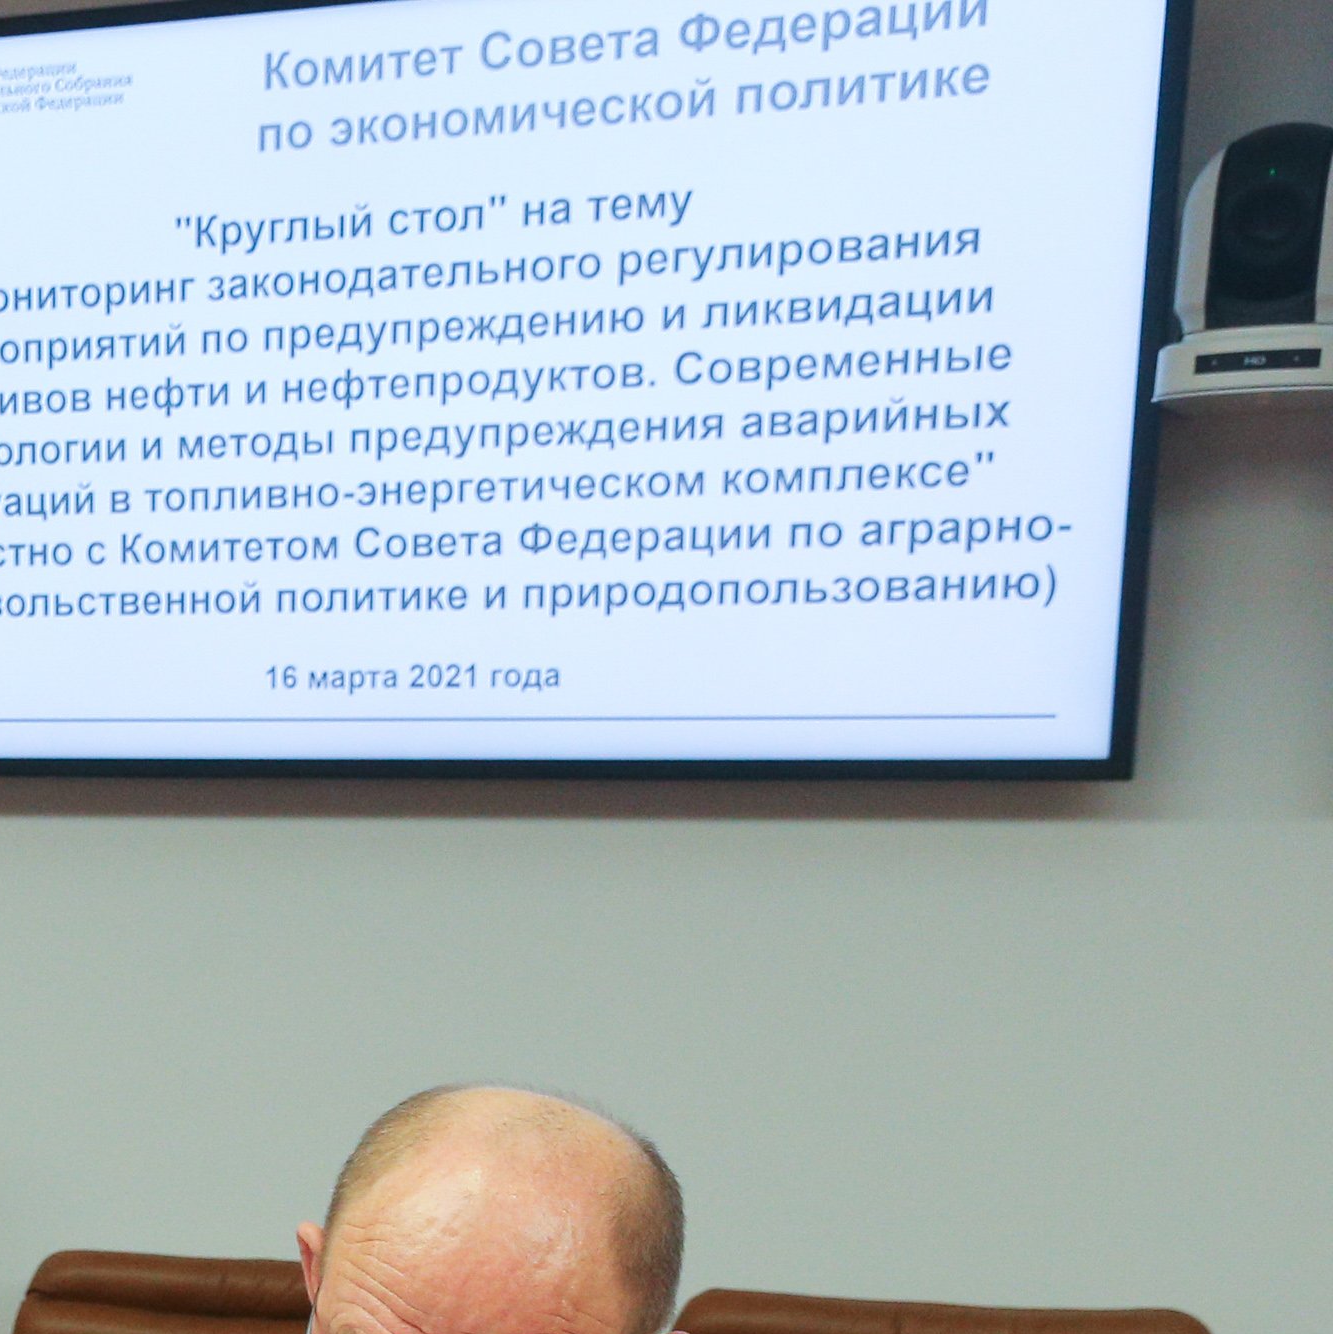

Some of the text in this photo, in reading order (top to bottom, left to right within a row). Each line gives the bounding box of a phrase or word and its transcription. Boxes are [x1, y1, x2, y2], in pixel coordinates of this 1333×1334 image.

[264, 0, 989, 91] Комитет Совета Федерации
[34, 92, 124, 112] Федерации
[258, 63, 991, 153] по экономической политике
[174, 189, 694, 257] "Круглый стол" на тему
[206, 252, 603, 302] законодательного
[617, 226, 981, 288] регулирования
[201, 326, 250, 355] по
[263, 305, 646, 360] предупреждению
[661, 303, 687, 332] и
[700, 285, 994, 330] ликвидации
[105, 375, 230, 419] нефти
[244, 379, 268, 406] и
[282, 361, 657, 411] нефтепродуктов.
[673, 342, 1014, 392] Современные
[141, 435, 163, 462] и
[177, 429, 335, 463] методы
[349, 412, 725, 463] предупреждения
[740, 396, 1011, 446] аварийных
[109, 489, 132, 515] в
[143, 469, 706, 514] топливно-энергетическом
[721, 450, 995, 496] комплексе"
[85, 540, 107, 566] с
[120, 532, 339, 566] Комитетом
[353, 525, 503, 560] Совета
[518, 521, 772, 563] Федерации
[788, 520, 845, 549] по
[858, 513, 1073, 556] аграрно-
[276, 584, 469, 614] политике
[483, 584, 508, 611] и
[522, 563, 1058, 618] природопользованию)
[265, 662, 561, 696] 16 марта 2021 года
